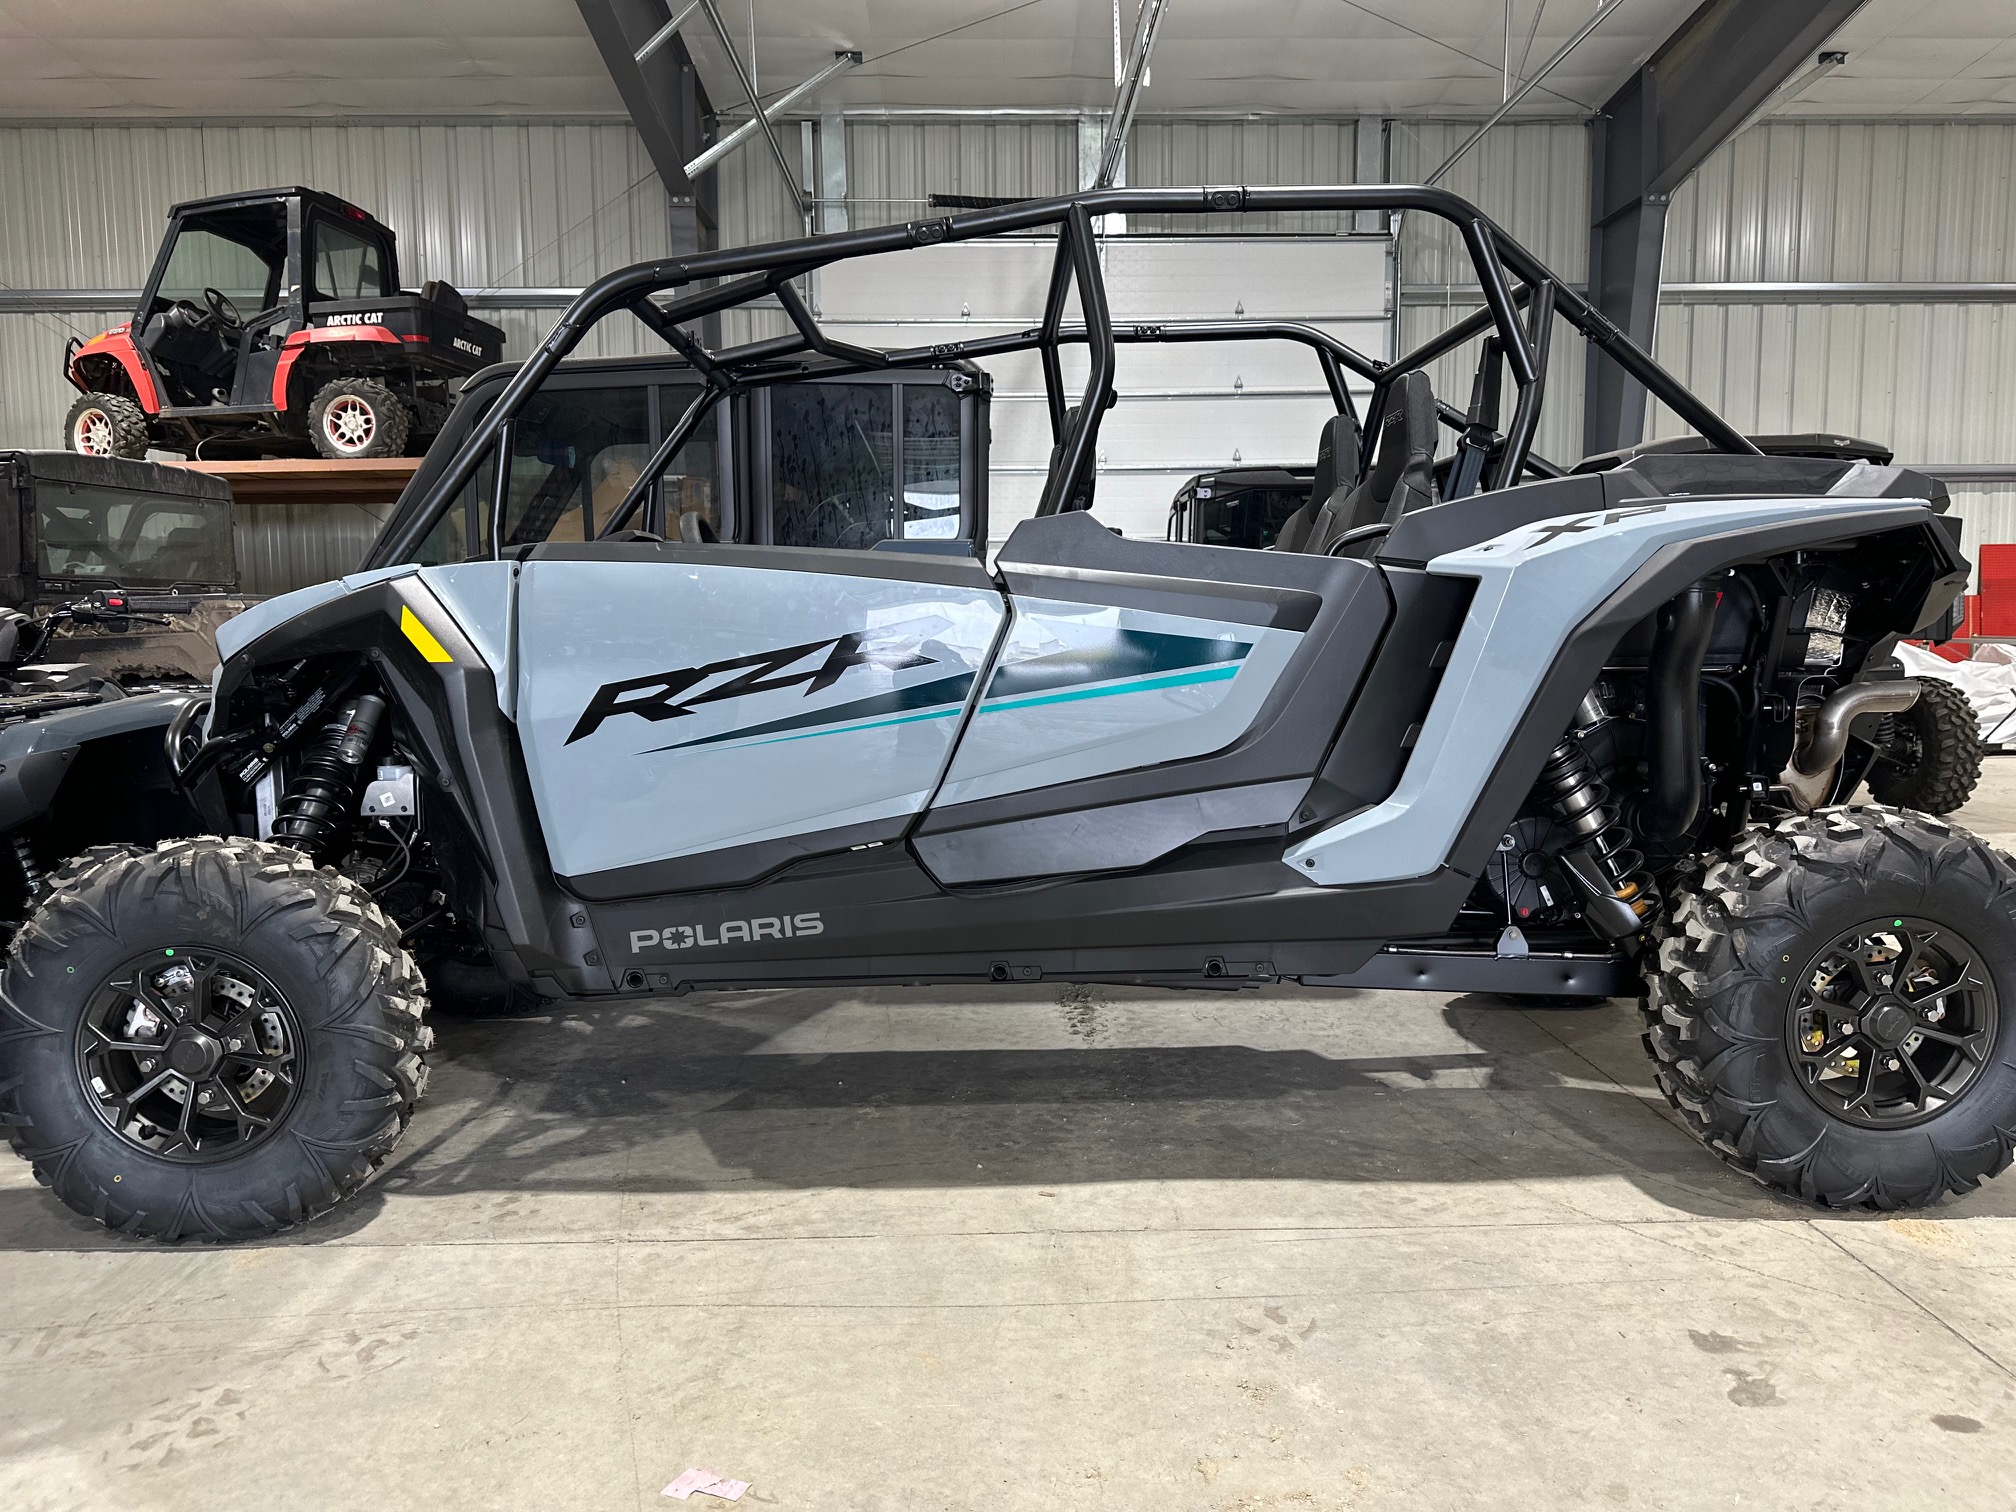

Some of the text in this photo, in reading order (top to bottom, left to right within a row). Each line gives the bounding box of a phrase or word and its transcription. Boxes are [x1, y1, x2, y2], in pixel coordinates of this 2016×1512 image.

[327, 312, 384, 326] ARCTIC CAT
[453, 337, 482, 357] ARCTIC CAT
[1522, 505, 1667, 551] XP
[563, 614, 955, 747] RZR
[239, 757, 258, 778] POLARIS
[629, 912, 824, 954] POLARIS
